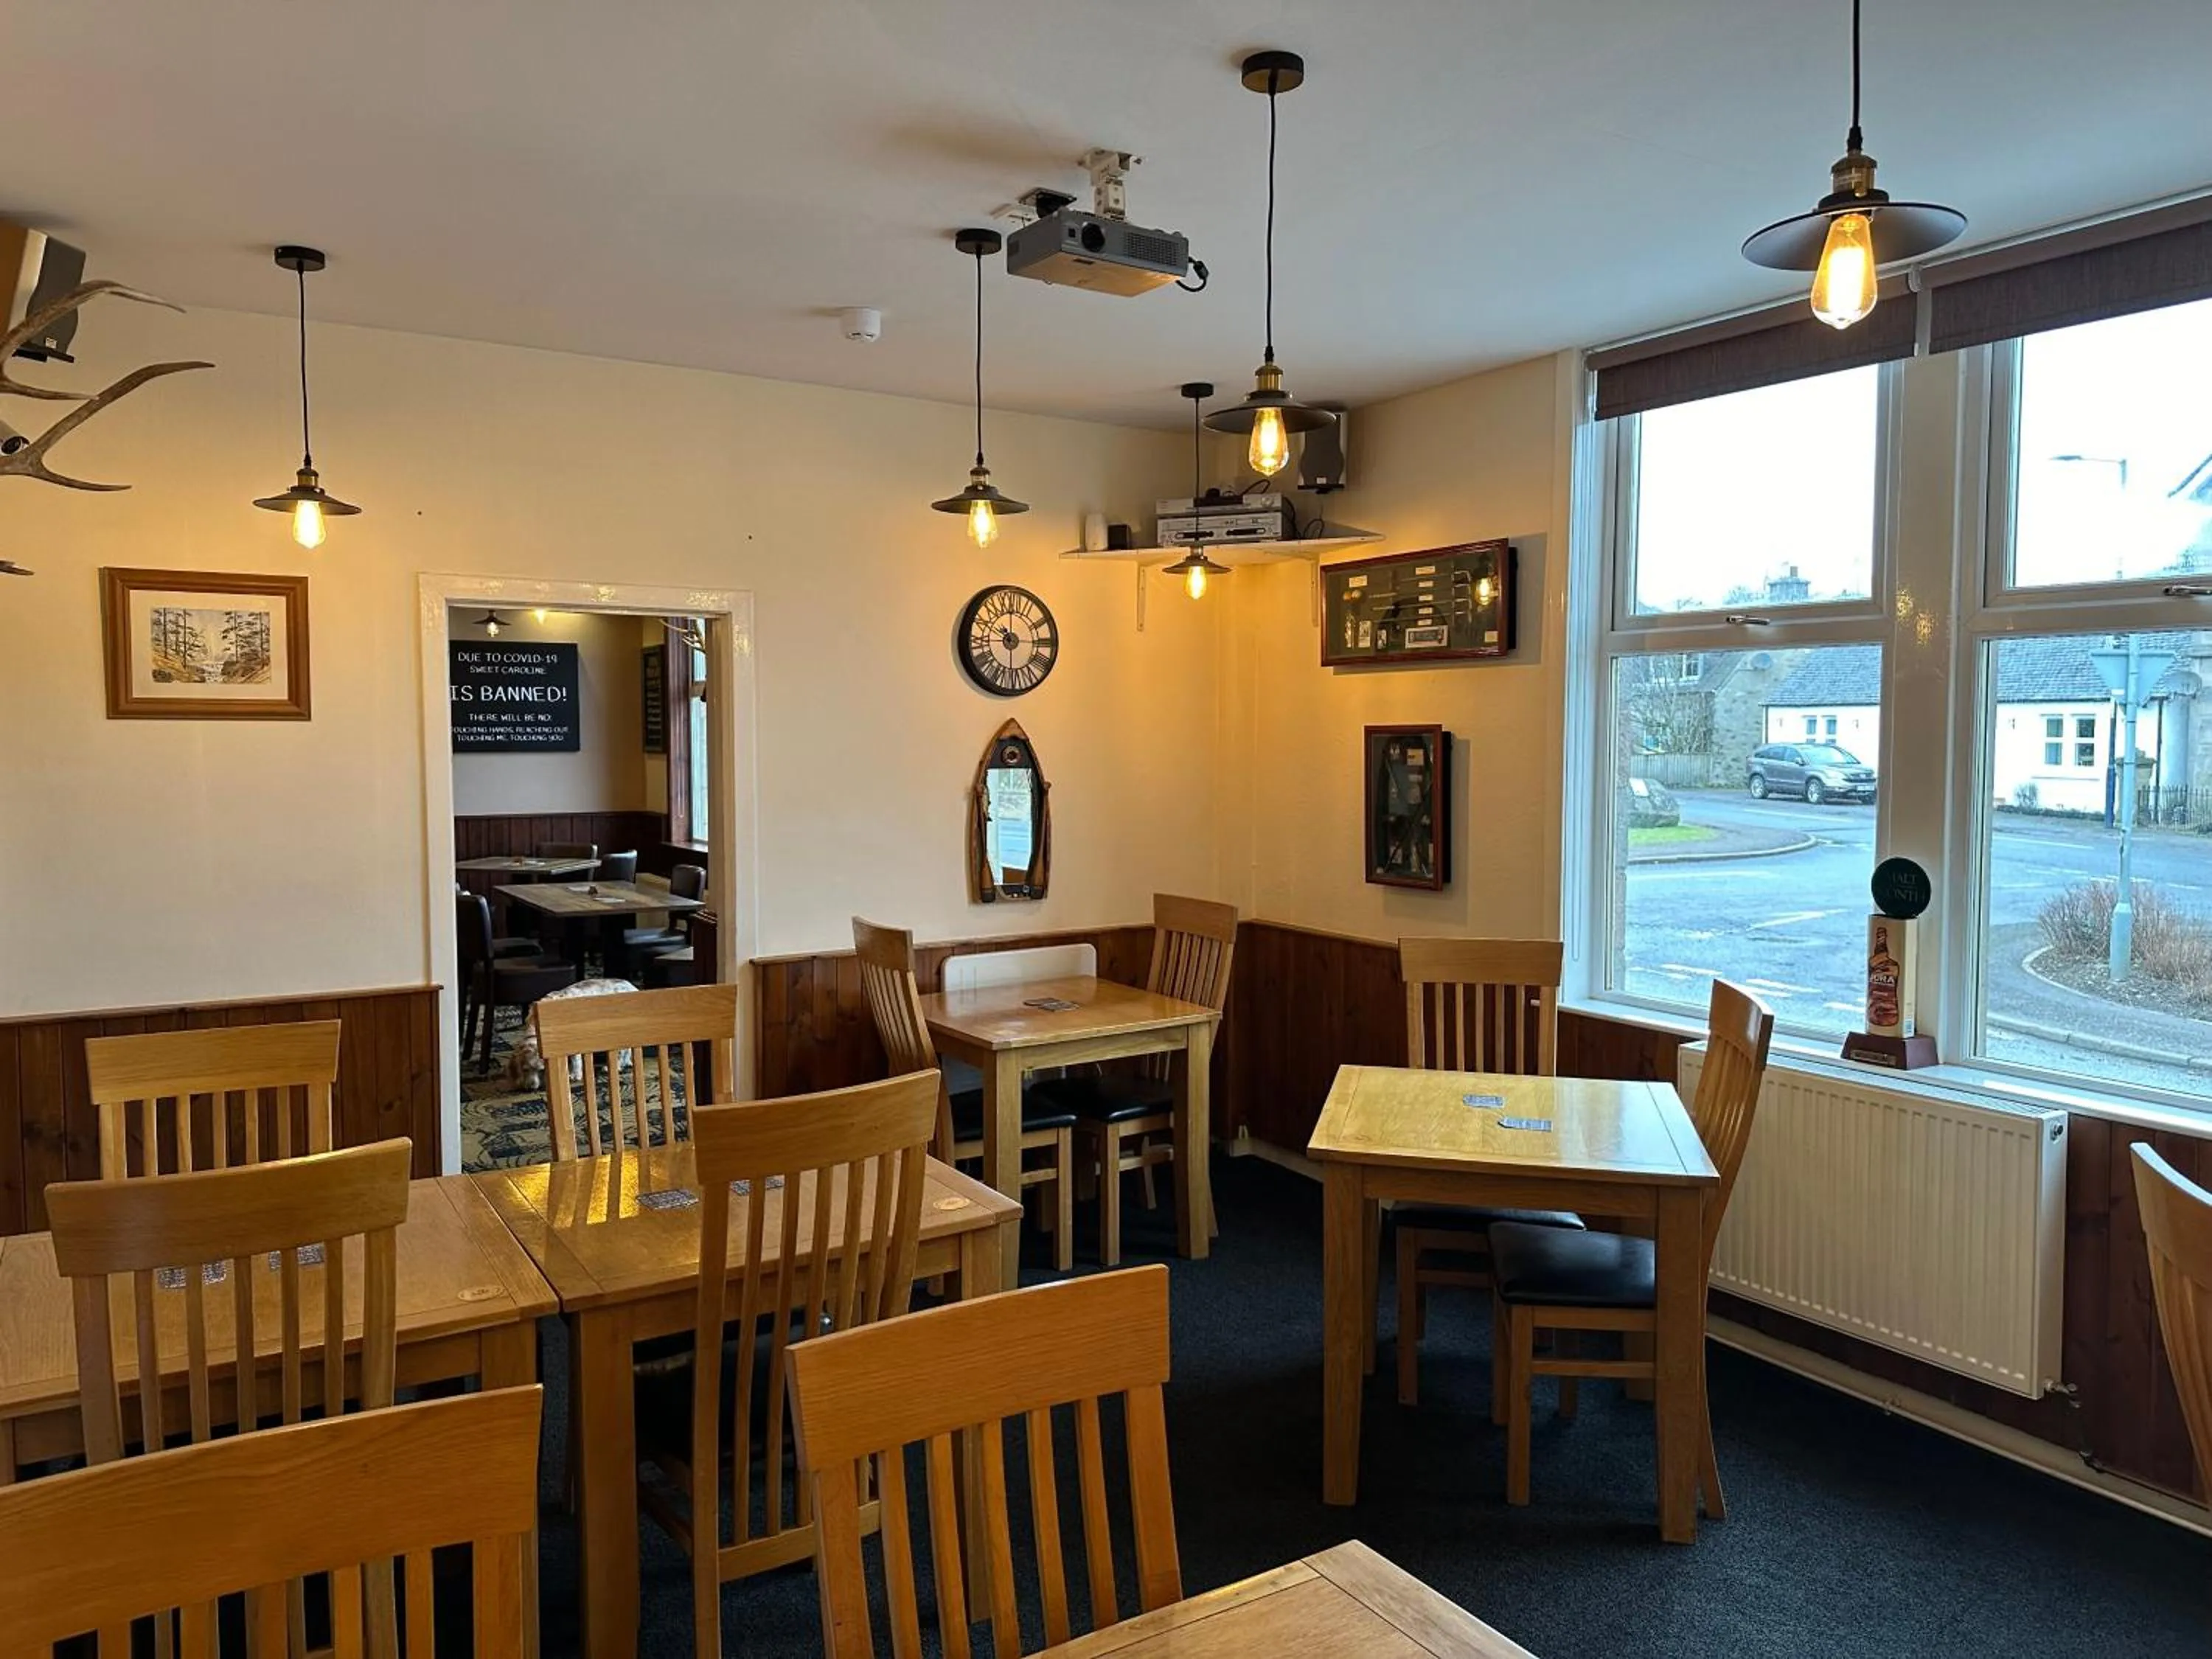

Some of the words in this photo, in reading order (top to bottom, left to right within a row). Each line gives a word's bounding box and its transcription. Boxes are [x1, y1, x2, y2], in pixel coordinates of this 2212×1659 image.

[458, 653, 481, 662] DUE
[485, 653, 501, 663] TO
[504, 653, 558, 664] COVID-19
[470, 665, 499, 674] SWEET
[501, 666, 547, 675] CAROLINE
[450, 684, 474, 701] IS
[480, 684, 568, 703] BANNED!
[469, 713, 498, 722] THERE
[501, 713, 521, 722] WILL
[524, 713, 536, 722] BE
[451, 726, 487, 734] OUCHING
[457, 734, 495, 742] TOUCHING
